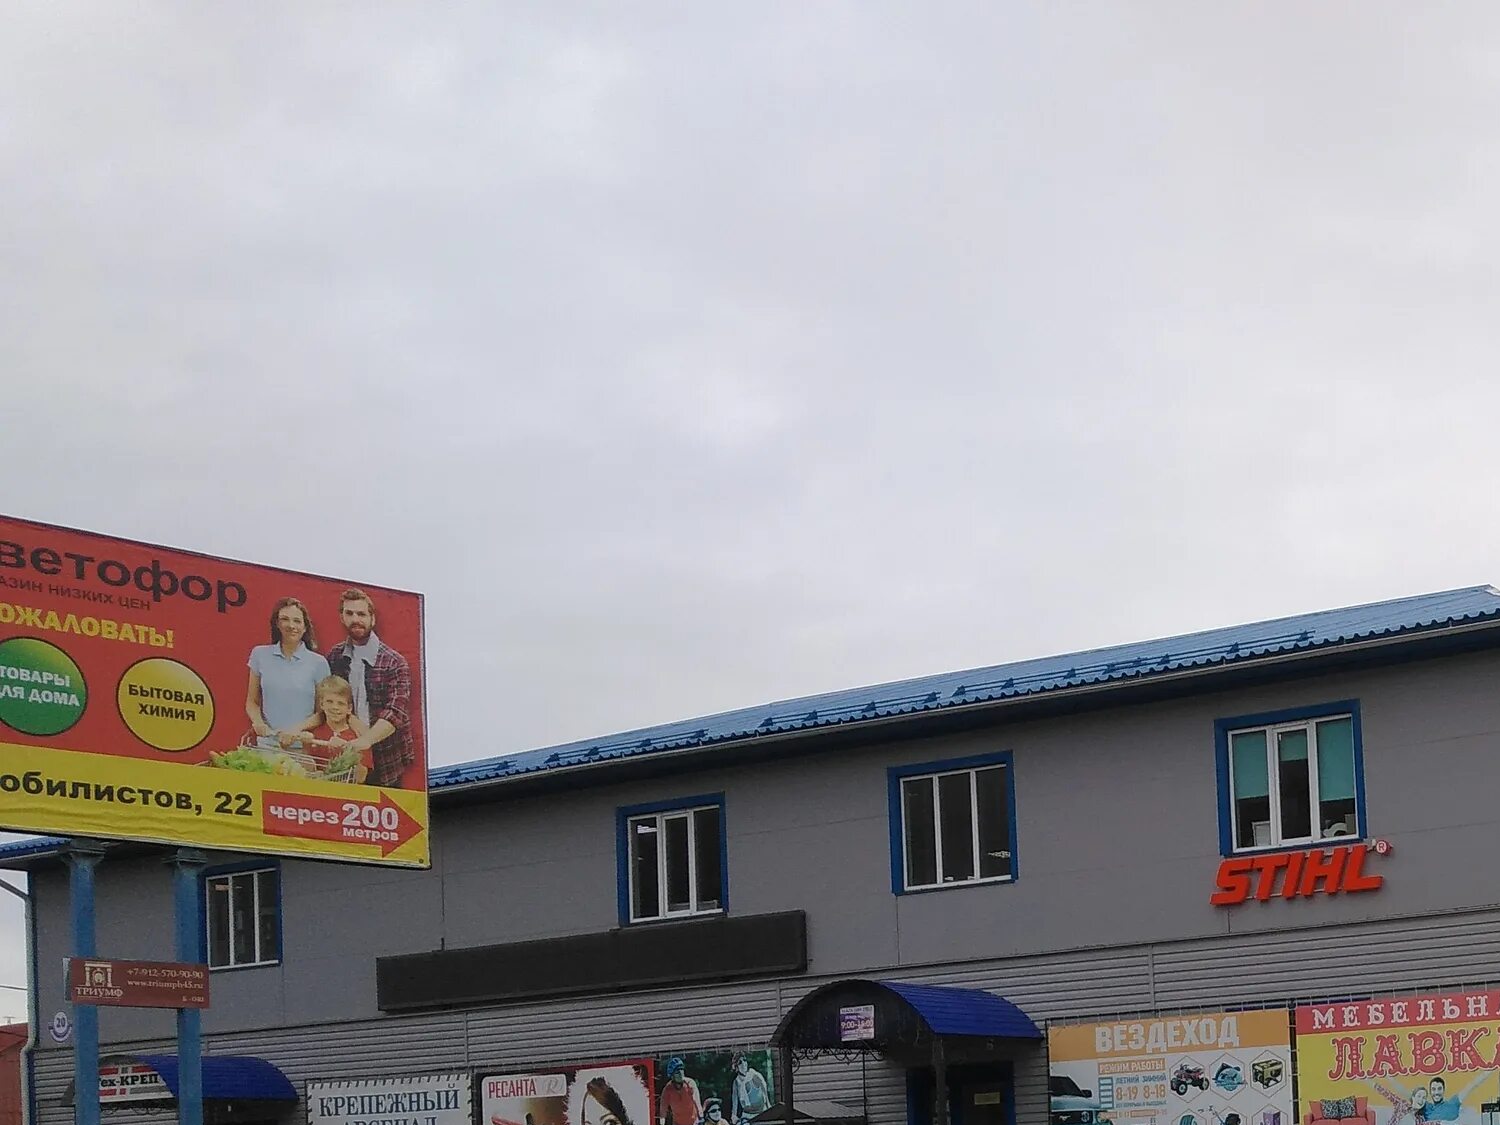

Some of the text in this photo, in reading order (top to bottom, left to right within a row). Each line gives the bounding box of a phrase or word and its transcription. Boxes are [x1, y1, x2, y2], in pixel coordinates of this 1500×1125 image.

[49, 583, 114, 604] НИЗКИХ
[119, 598, 150, 611] ЦЕН
[0, 684, 80, 707] ЛЯ ДОМА
[128, 684, 205, 705] БЫТОВАЯ
[138, 703, 196, 721] ХИМИЯ
[214, 791, 253, 816] 22
[269, 803, 398, 830] через 200
[343, 826, 399, 842] метров
[1210, 844, 1383, 907] STIHL
[75, 986, 123, 997] ТРИУМФ
[56, 1017, 66, 1028] 20
[1095, 1016, 1240, 1054] ВЕЗДЕХОД
[1131, 1060, 1164, 1072] РАБОТЫ
[100, 1073, 159, 1087] ех-КРЕП
[488, 1079, 537, 1099] РЕСАНТА
[319, 1083, 460, 1117] КРЕПЕЖНЫЙ
[1115, 1084, 1166, 1100] 8-19 8-18
